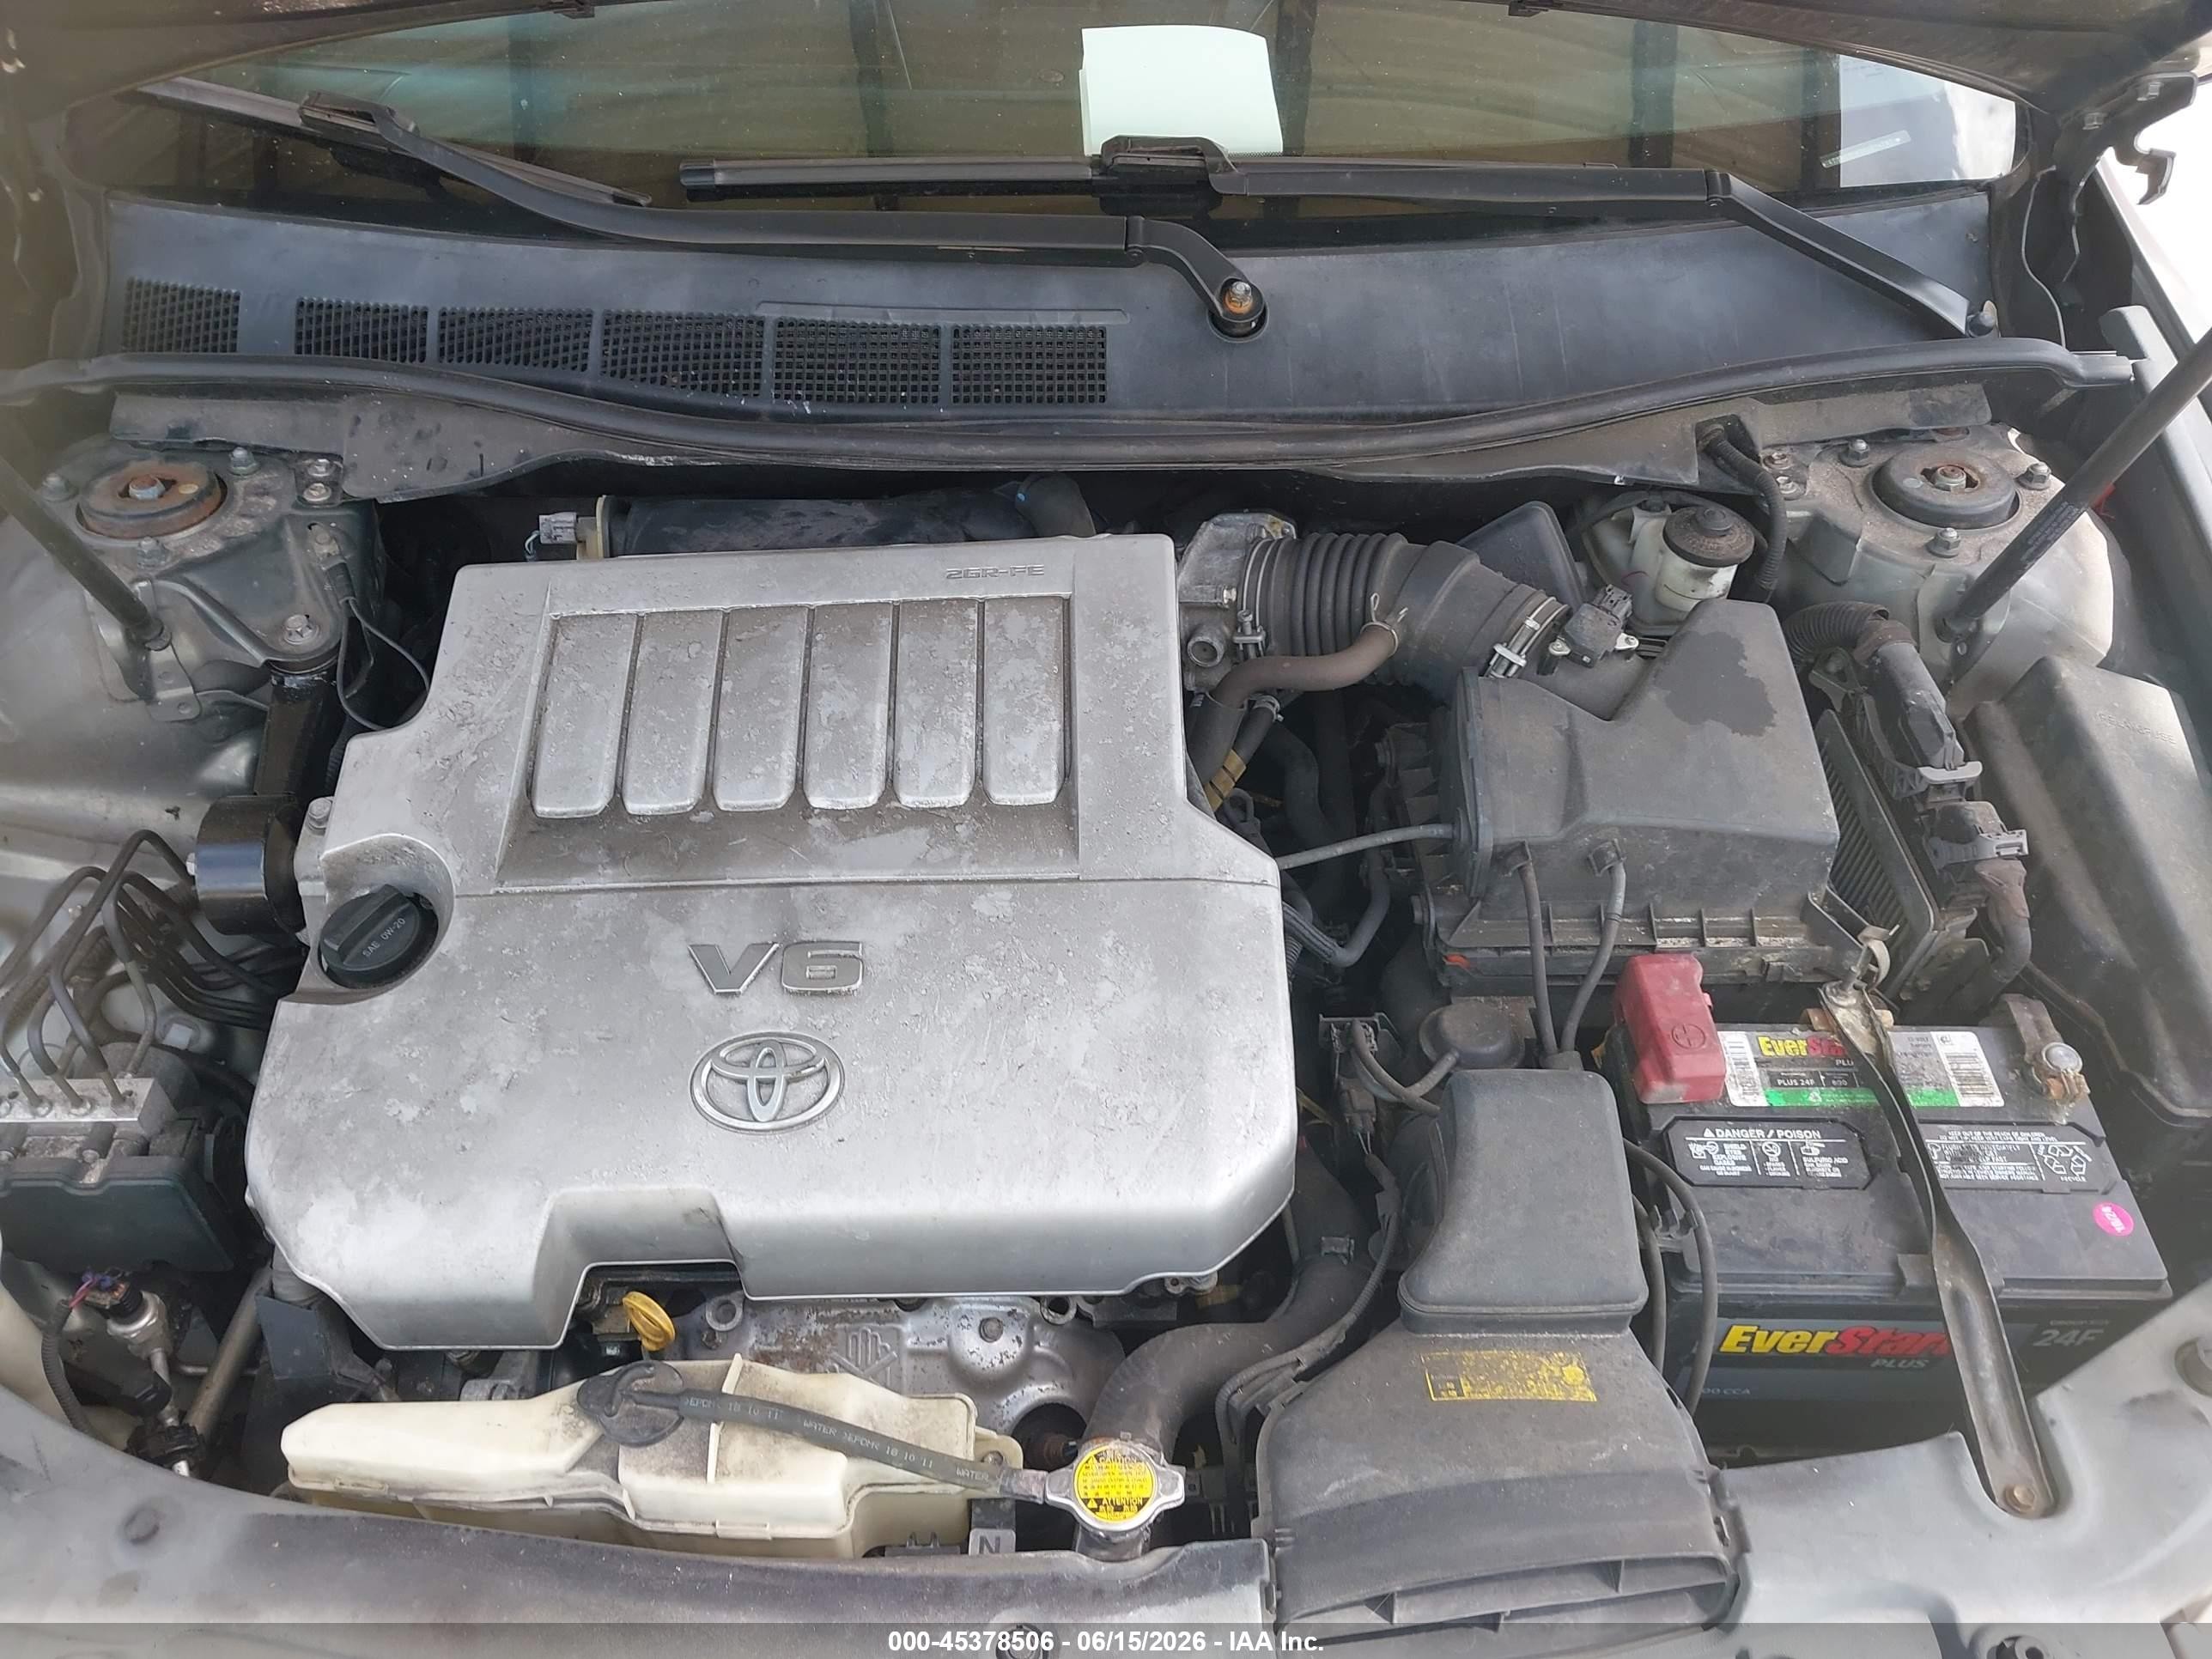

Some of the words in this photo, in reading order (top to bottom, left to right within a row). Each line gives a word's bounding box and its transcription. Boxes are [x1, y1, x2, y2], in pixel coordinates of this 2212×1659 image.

[945, 563, 1045, 580] 2GR-FE
[362, 940, 380, 957] SAE
[380, 917, 406, 940] 0W-20
[687, 941, 864, 994] V6
[1715, 1128, 1765, 1139] DANGER
[1777, 1129, 1821, 1139] POISON
[1720, 1324, 1952, 1356] EverStar
[2033, 1328, 2105, 1346] 24F
[1871, 1358, 1929, 1369] PLUS
[1723, 1387, 1752, 1395] CCA
[803, 1419, 837, 1437] WATER
[956, 1467, 989, 1481] WATER
[1102, 1497, 1143, 1505] ATTENTION
